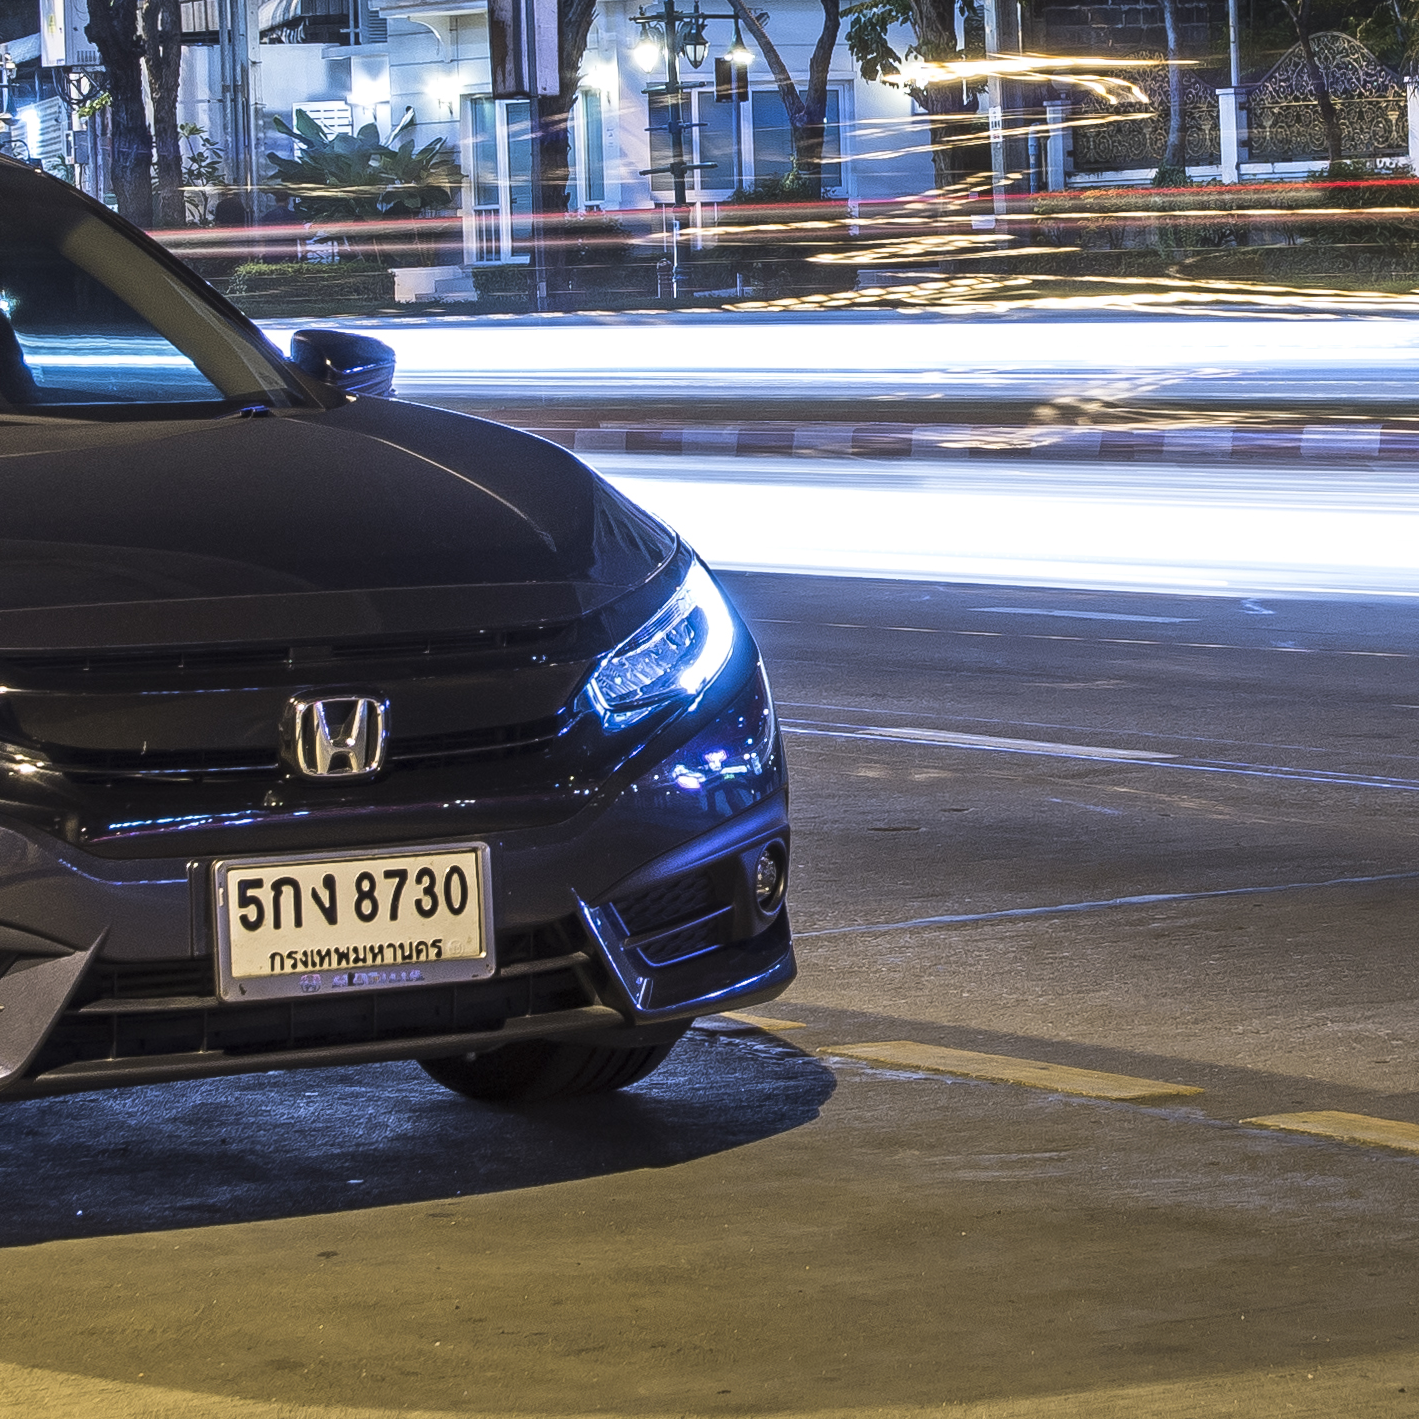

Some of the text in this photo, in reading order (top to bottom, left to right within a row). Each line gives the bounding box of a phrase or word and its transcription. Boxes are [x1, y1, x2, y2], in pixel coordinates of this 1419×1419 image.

[237, 864, 469, 932] 5กง 8730
[269, 938, 443, 972] กรงเทพมหานคร
